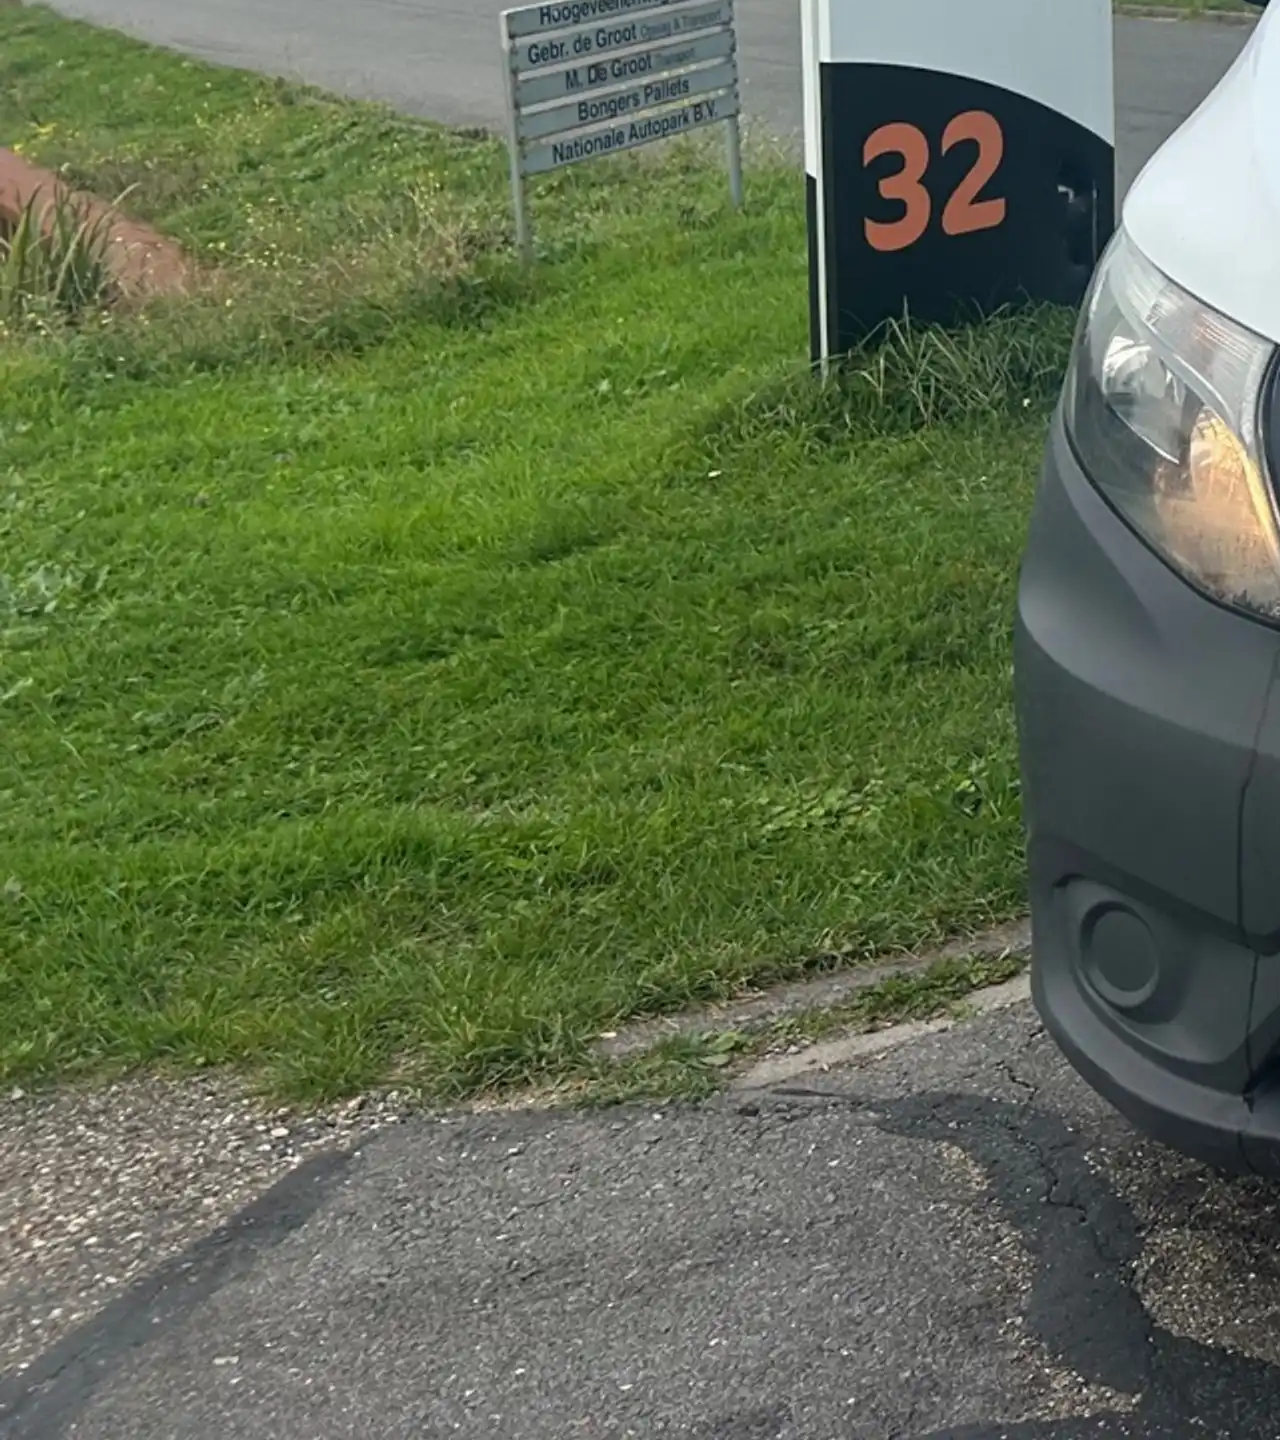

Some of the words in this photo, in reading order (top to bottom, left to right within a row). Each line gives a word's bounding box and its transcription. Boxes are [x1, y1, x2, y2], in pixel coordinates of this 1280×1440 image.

[527, 39, 570, 64] Gebr.
[573, 33, 591, 53] de
[596, 23, 637, 48] Groot
[565, 70, 583, 90] M.
[587, 63, 607, 82] De
[611, 54, 652, 77] Groot
[577, 92, 640, 122] Bongers
[644, 77, 689, 105] Pallets
[552, 126, 625, 165] Nationale
[628, 108, 689, 141] Autopark
[694, 100, 718, 122] B.V.
[862, 109, 1007, 253] 32
